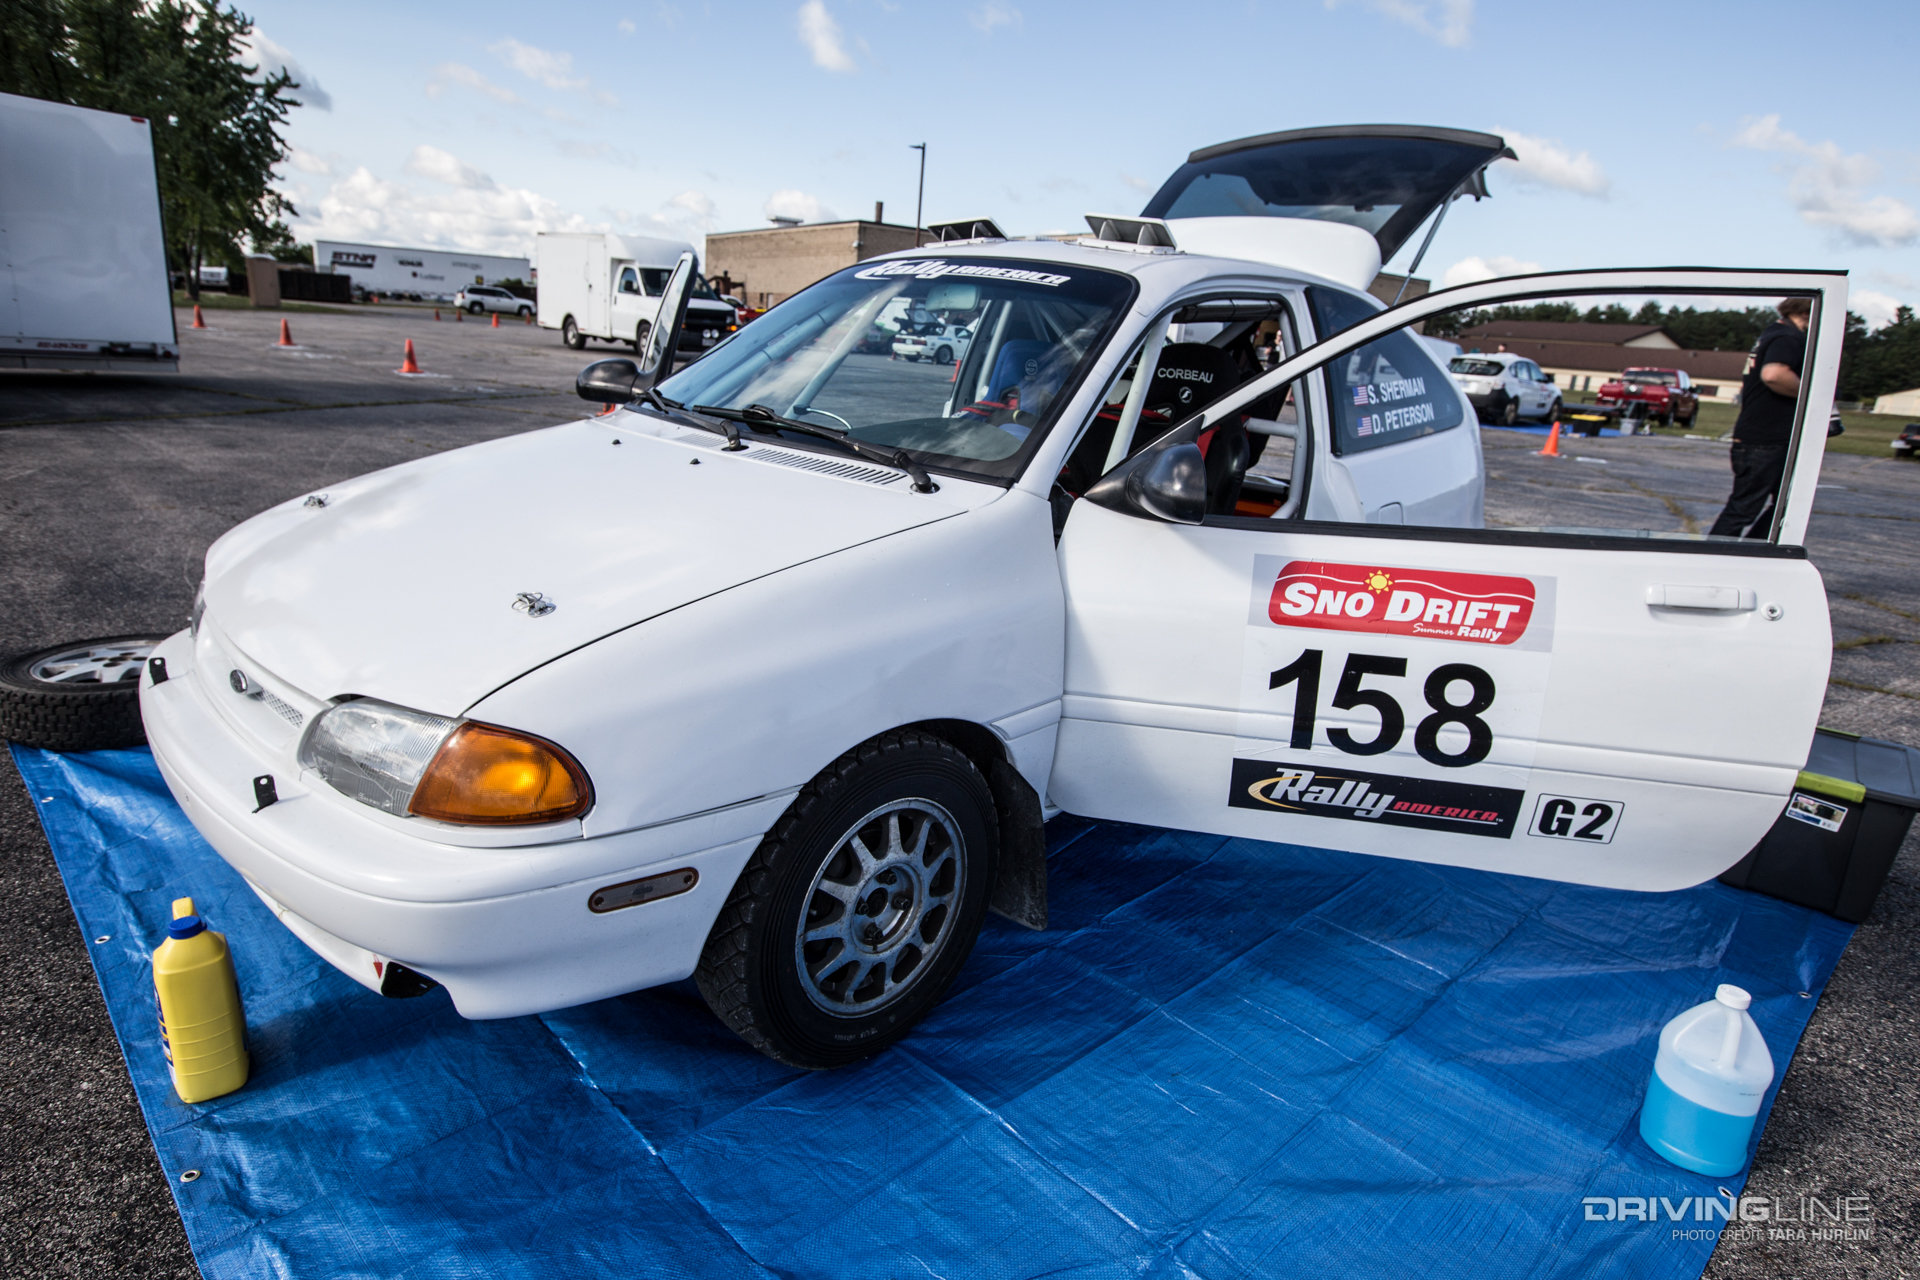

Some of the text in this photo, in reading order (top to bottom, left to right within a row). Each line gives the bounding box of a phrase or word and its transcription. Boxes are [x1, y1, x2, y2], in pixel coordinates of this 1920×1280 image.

[868, 260, 1071, 286] Rally AMERICA
[1157, 367, 1214, 383] CORBEAU
[1367, 376, 1426, 405] S. SHERMAN
[1372, 402, 1435, 435] D. PETERSON
[1412, 622, 1502, 642] Summer Rally
[1268, 648, 1496, 768] 158
[1271, 767, 1395, 819] Rally
[1537, 798, 1614, 841] G2
